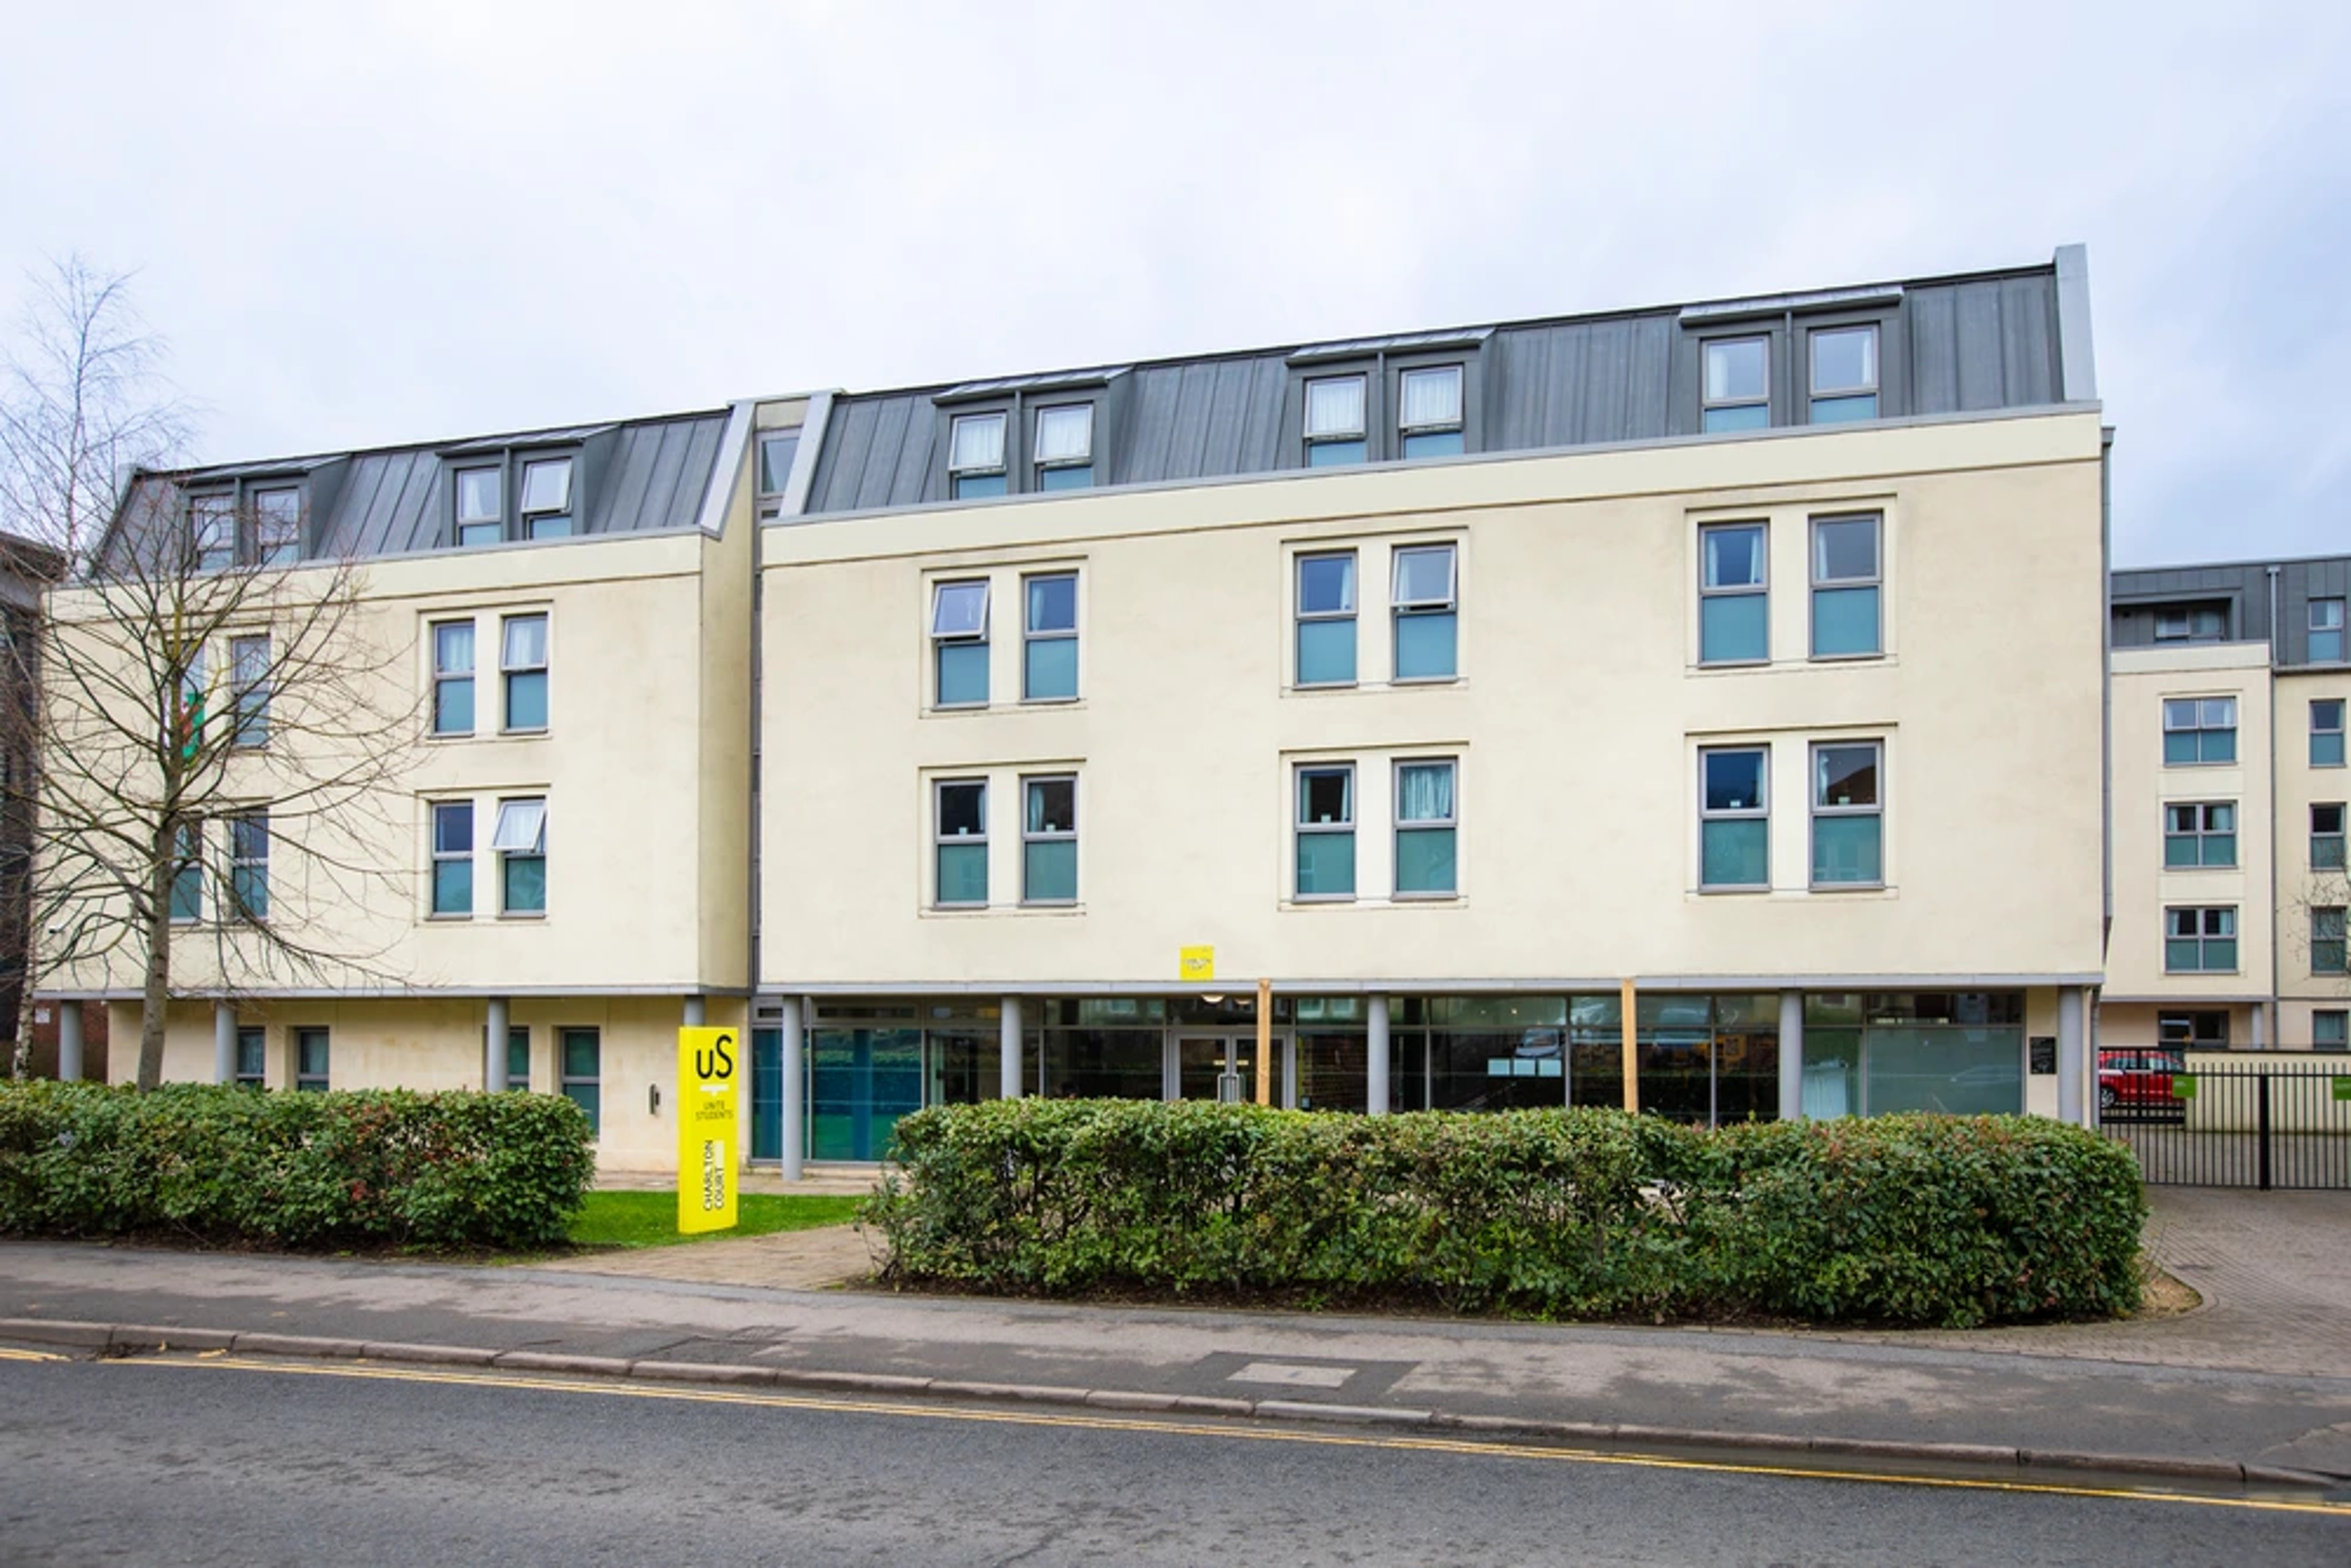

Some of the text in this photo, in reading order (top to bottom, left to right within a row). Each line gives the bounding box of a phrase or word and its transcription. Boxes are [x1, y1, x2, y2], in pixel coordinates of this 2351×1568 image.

[696, 1109, 734, 1121] STUDENTS
[703, 1100, 725, 1110] UNITE
[703, 1139, 713, 1211] CHARLTON
[714, 1166, 724, 1210] COURT
